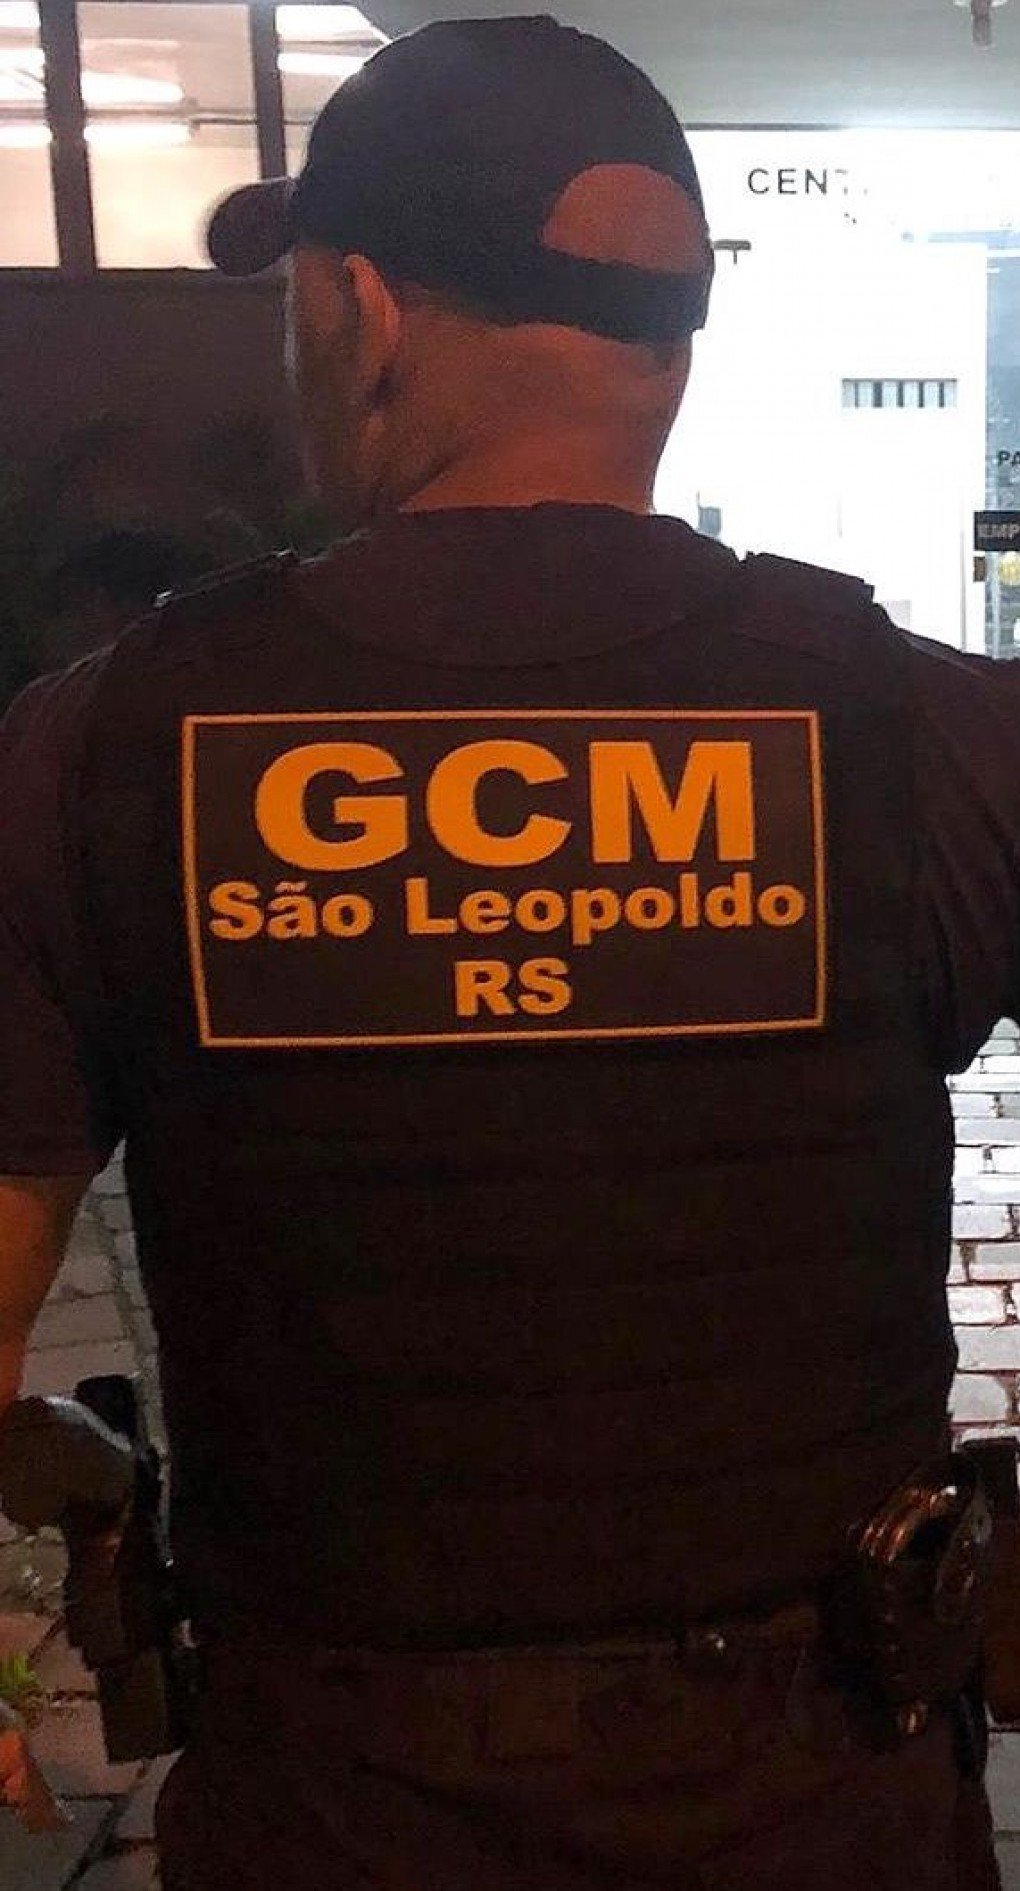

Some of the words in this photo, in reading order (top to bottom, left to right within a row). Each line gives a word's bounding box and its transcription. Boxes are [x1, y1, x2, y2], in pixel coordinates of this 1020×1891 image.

[255, 739, 756, 872] GCM
[209, 879, 374, 940] São
[406, 872, 806, 946] Leopoldo
[454, 957, 573, 1016] RS
